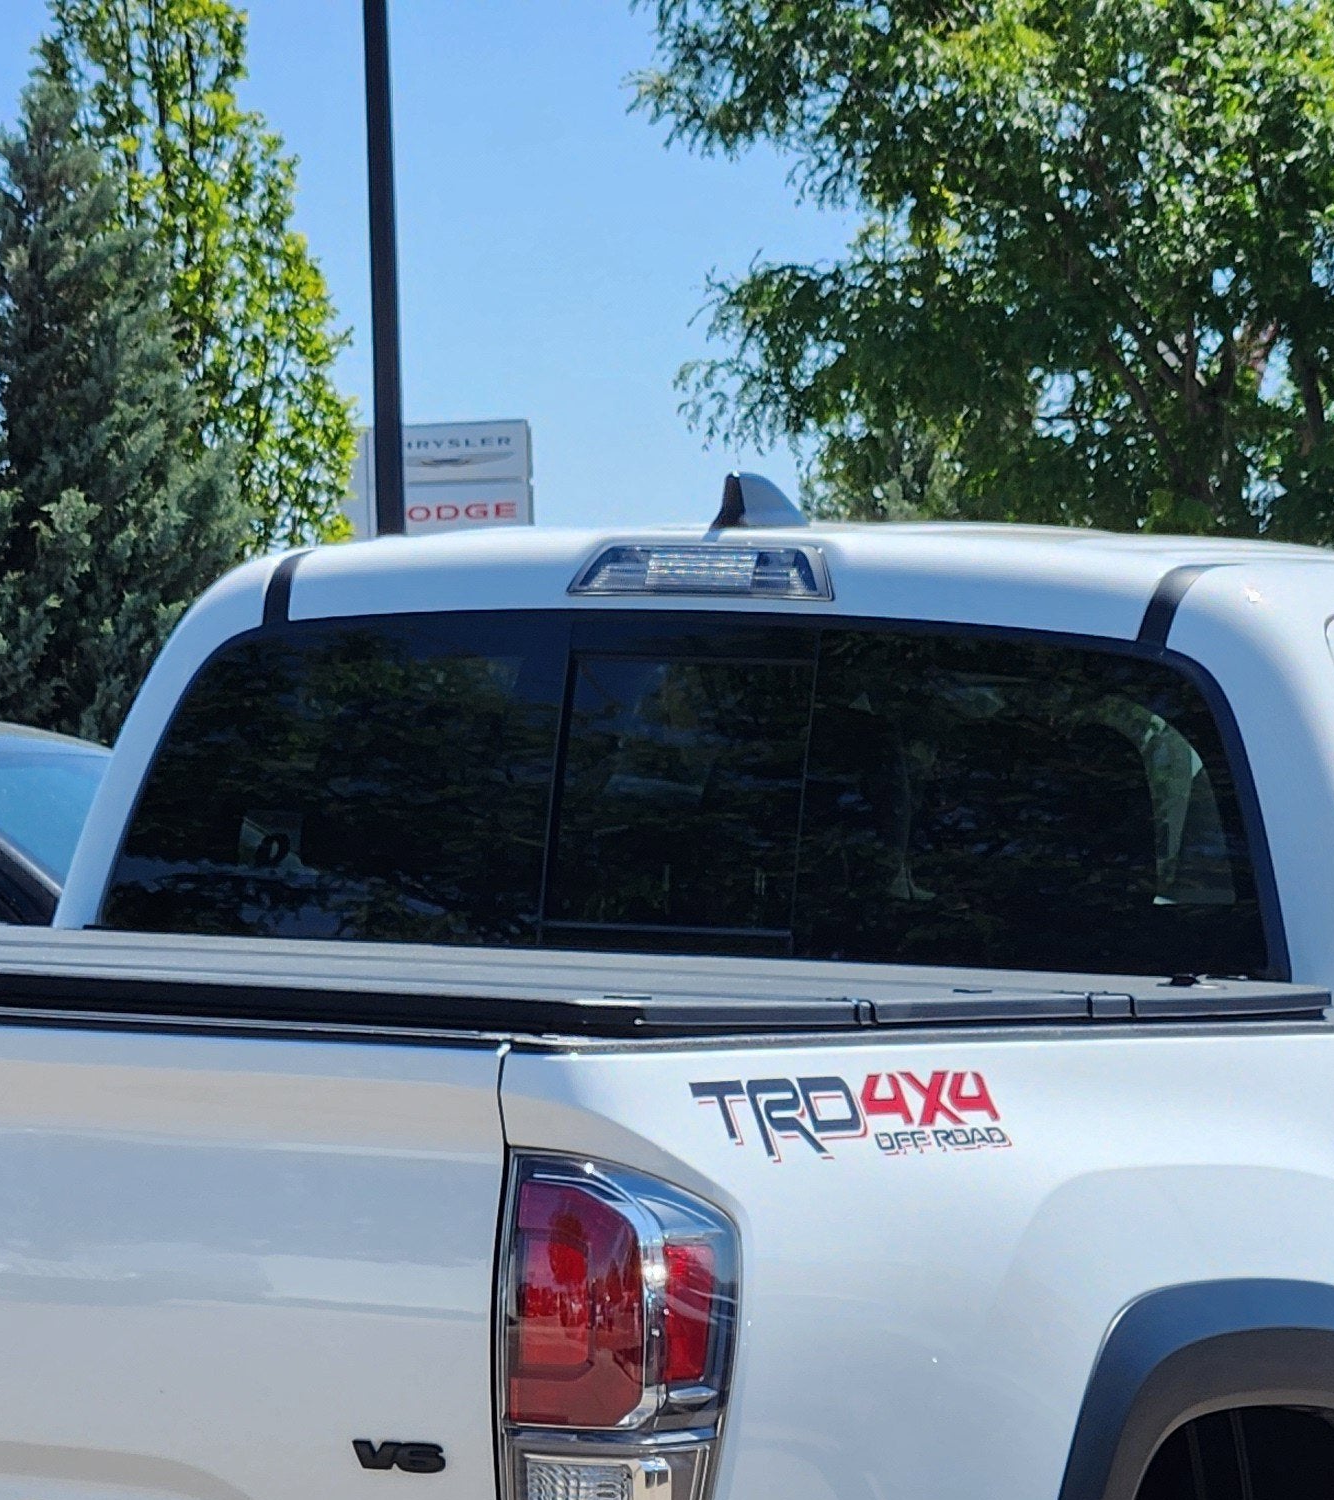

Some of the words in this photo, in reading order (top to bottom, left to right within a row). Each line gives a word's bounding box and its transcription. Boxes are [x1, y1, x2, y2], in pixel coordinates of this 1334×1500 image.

[408, 502, 517, 521] ODGE
[688, 1076, 868, 1162] TRD
[874, 1127, 932, 1156] OFF
[933, 1125, 1013, 1153] ROAD
[352, 1439, 446, 1473] V6
